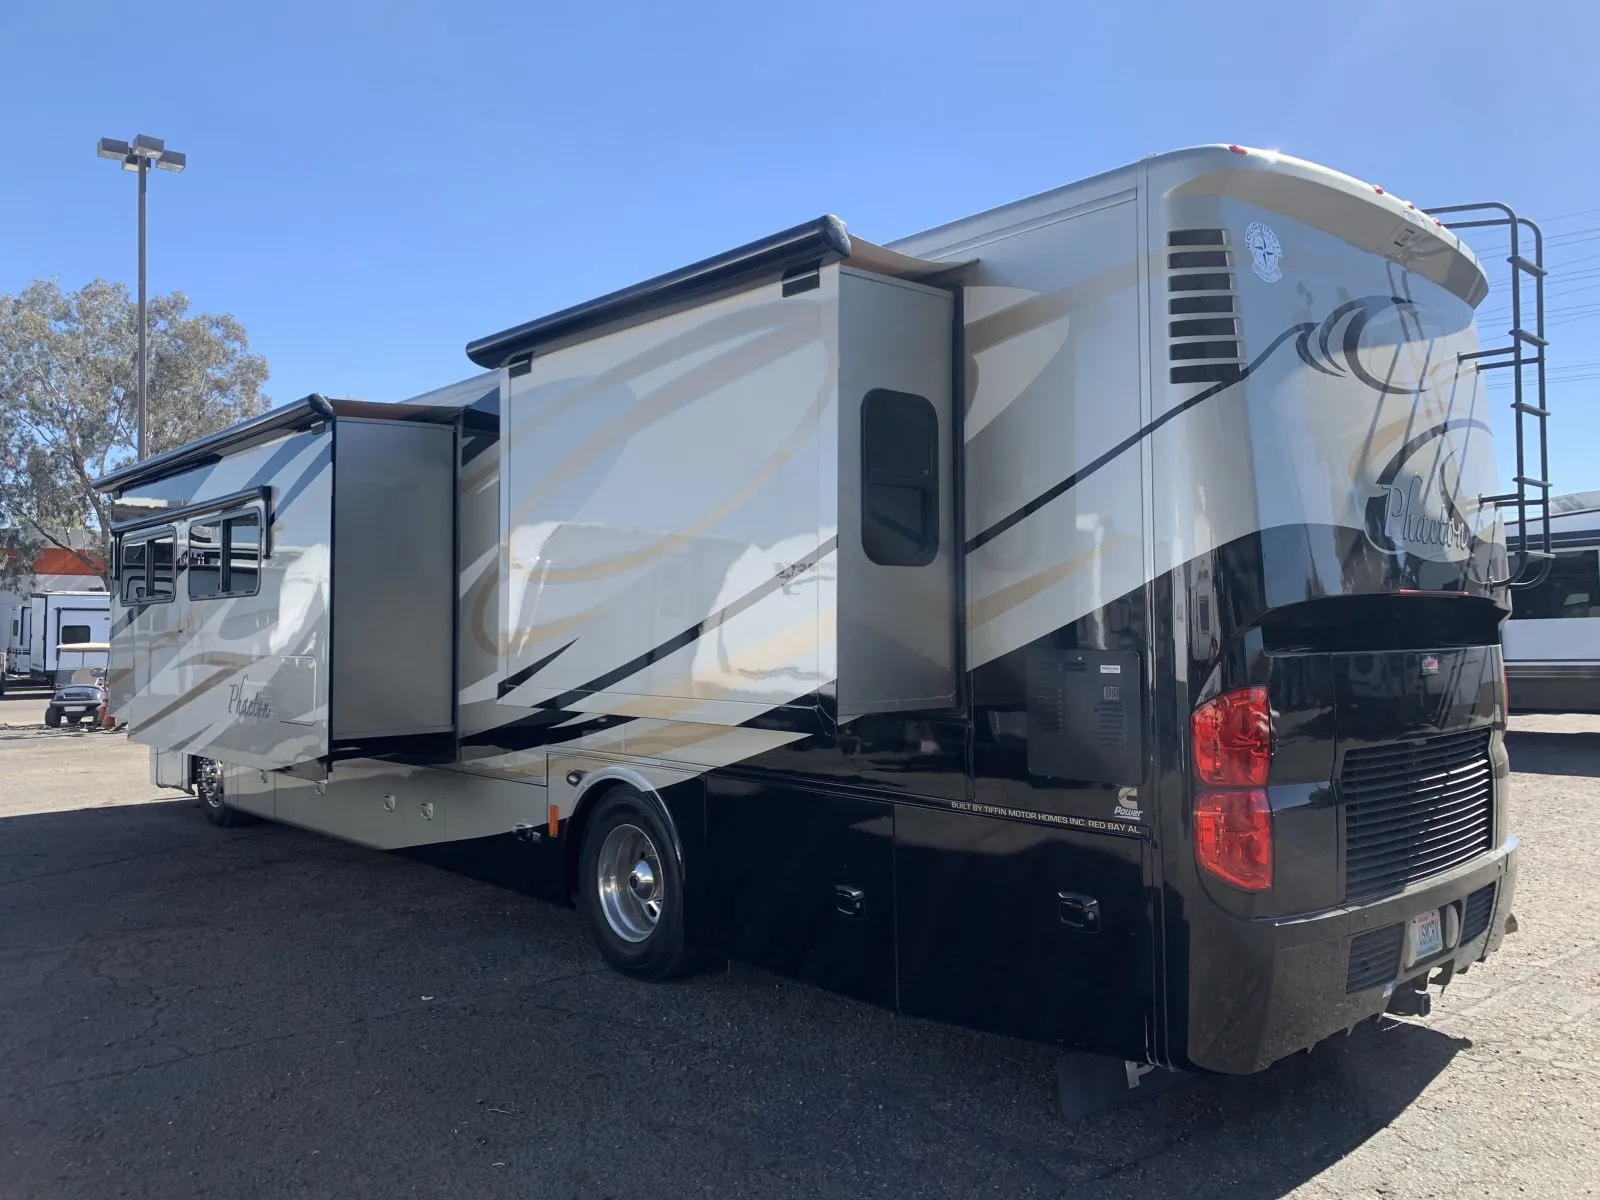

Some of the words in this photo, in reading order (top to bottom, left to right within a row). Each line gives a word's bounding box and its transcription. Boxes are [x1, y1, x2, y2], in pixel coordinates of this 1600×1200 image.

[1382, 474, 1469, 549] Phaeton
[228, 673, 272, 719] Phaeton
[951, 801, 971, 810] BUILT
[972, 804, 983, 812] BY
[984, 806, 1007, 816] TIFFIN
[1008, 809, 1037, 820] MOTOR
[1038, 813, 1068, 824] HOMES
[1069, 817, 1087, 827] INC.
[1088, 820, 1106, 829] RED
[1107, 822, 1126, 832] BAY
[1114, 806, 1143, 818] Power
